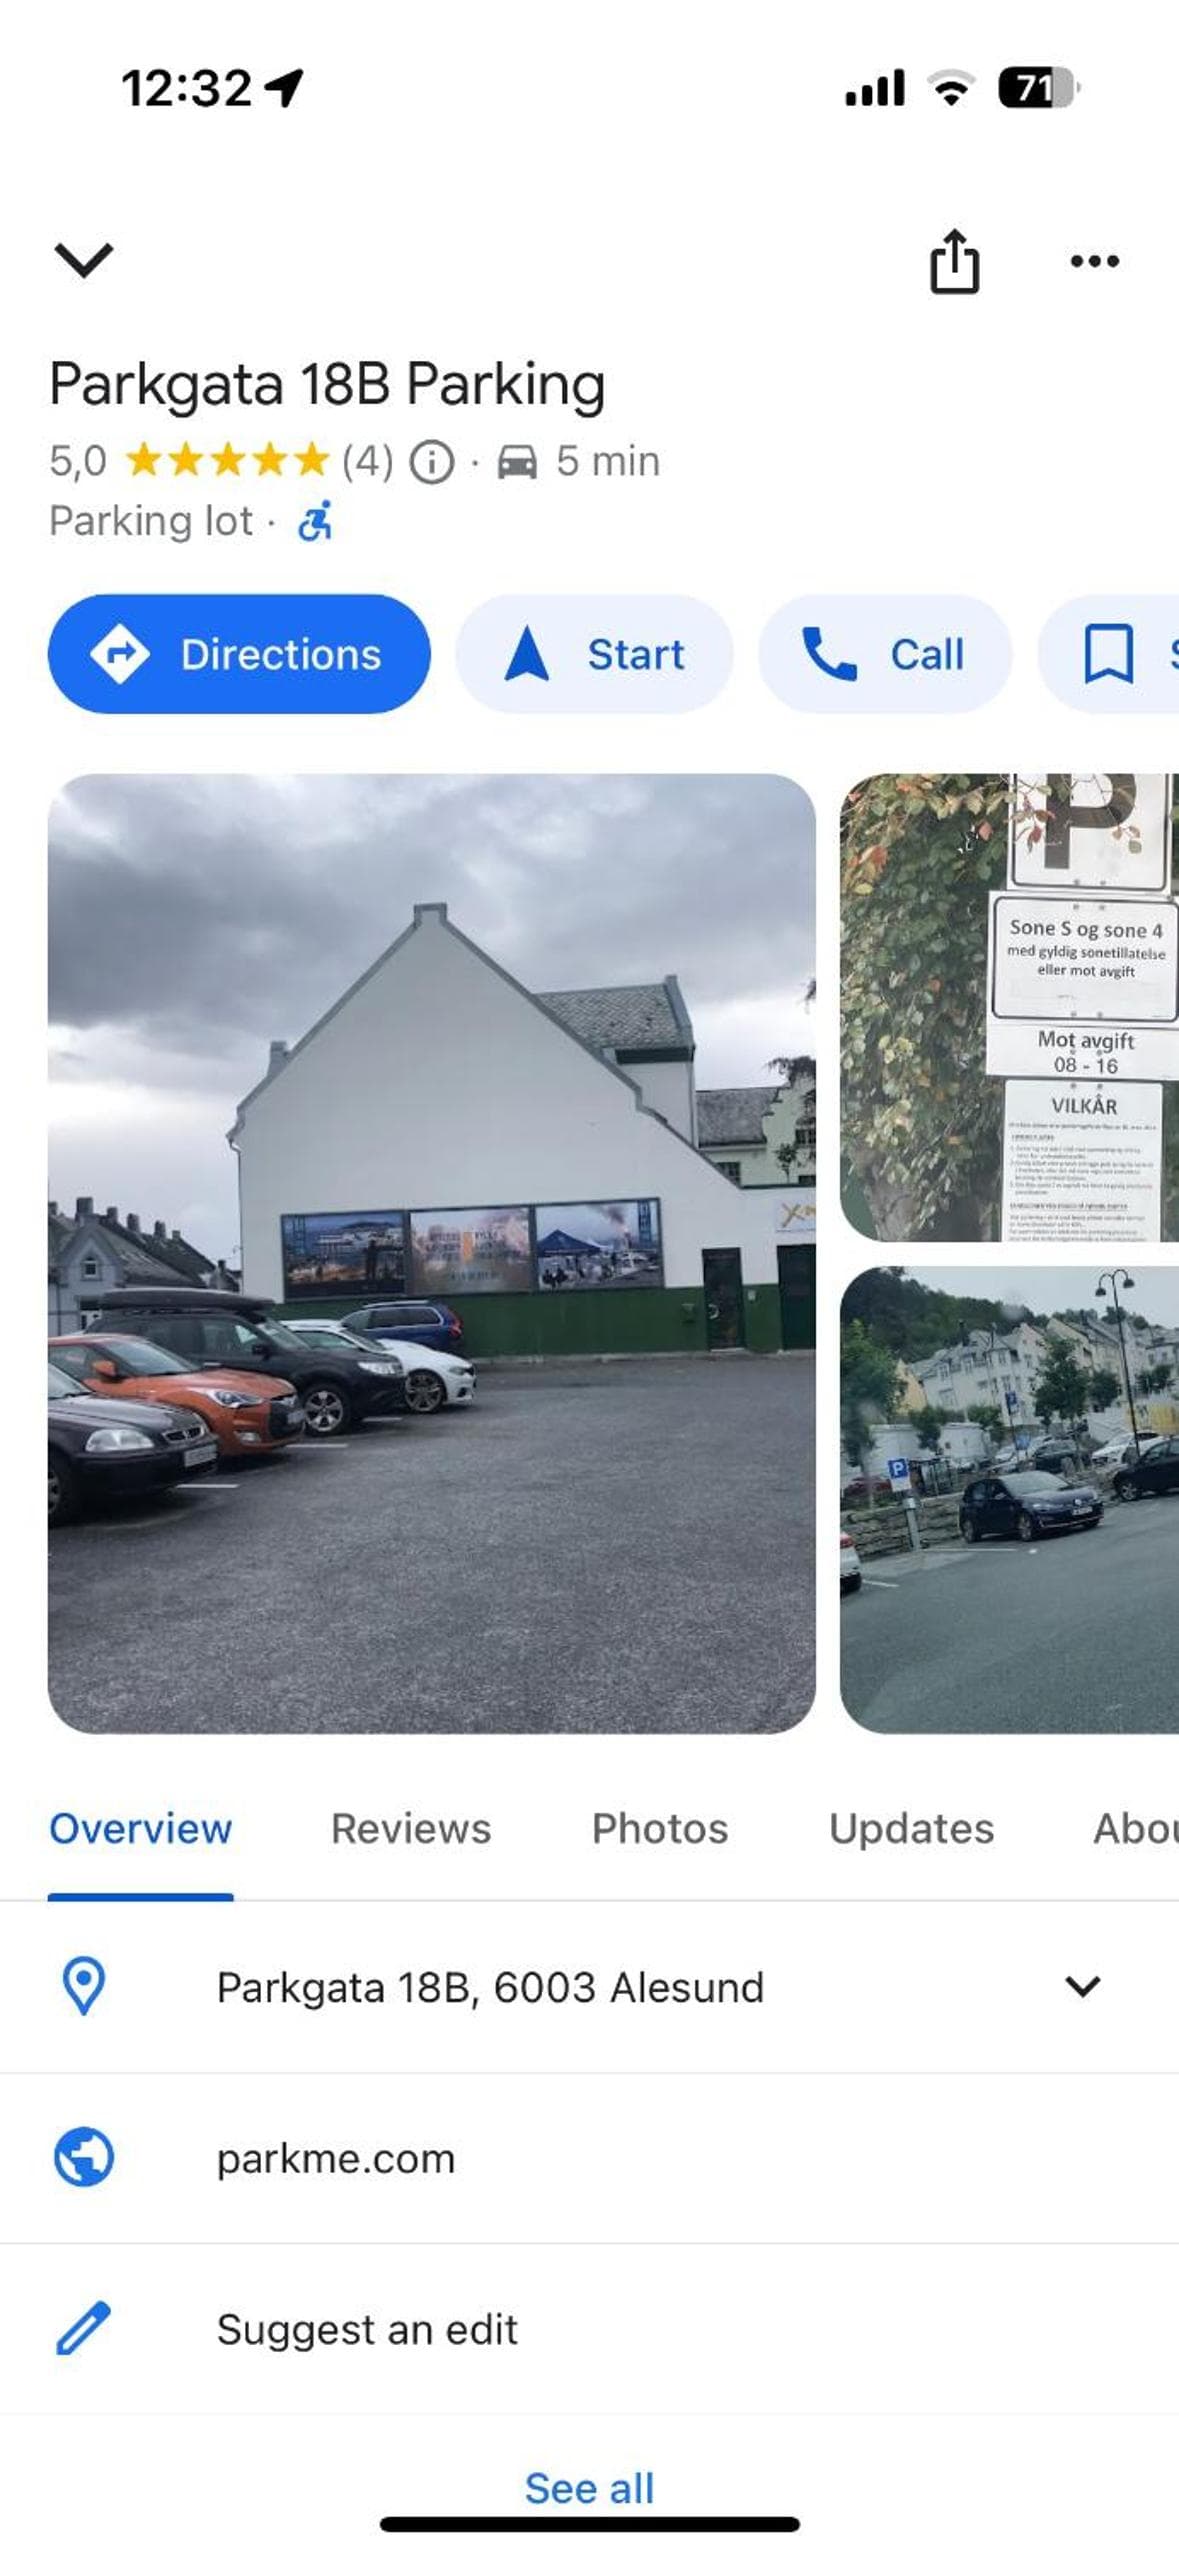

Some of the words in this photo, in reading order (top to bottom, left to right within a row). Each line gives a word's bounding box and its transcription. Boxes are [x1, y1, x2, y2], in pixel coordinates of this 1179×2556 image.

[122, 68, 251, 108] 12:32
[1017, 74, 1052, 101] 71
[52, 361, 282, 418] Parkgata
[302, 361, 390, 406] 18B
[409, 360, 604, 418] Parking
[51, 444, 106, 483] 5,0
[344, 444, 392, 483] (4)
[558, 445, 578, 476] 5
[594, 444, 659, 476] min
[51, 504, 191, 544] Parking
[207, 504, 253, 536] lot
[182, 637, 383, 672] Directions
[589, 638, 685, 670] Start
[892, 637, 963, 670] Call
[1044, 773, 1137, 869] P
[1010, 919, 1056, 936] Sone
[1061, 920, 1071, 937] S
[1077, 925, 1099, 940] og
[1103, 925, 1148, 939] sone
[1152, 923, 1163, 939] 4
[1007, 944, 1035, 957] med
[1038, 945, 1078, 960] gyldig
[1081, 946, 1166, 961] sonetillatelse
[1037, 963, 1067, 976] eller
[1070, 965, 1097, 977] mot
[1100, 965, 1136, 980] avgift
[1038, 1030, 1076, 1048] Mot
[1081, 1032, 1135, 1054] avgift
[1054, 1056, 1077, 1073] 08
[1097, 1058, 1118, 1074] 16
[1052, 1093, 1118, 1115] VILKÅR
[49, 1811, 232, 1845] Overview
[333, 1811, 491, 1844] Reviews
[594, 1811, 728, 1844] Photos
[831, 1811, 994, 1851] Updates
[1093, 1811, 1179, 1844] Abo
[219, 1971, 384, 2011] Parkgata
[399, 1971, 480, 2010] 18B,
[495, 1971, 595, 2003] 6003
[610, 1971, 764, 2003] Alesund
[218, 2141, 455, 2181] parkme.com
[218, 2313, 376, 2352] Suggest
[388, 2321, 432, 2345] an
[446, 2312, 518, 2345] edit
[526, 2472, 597, 2505] See
[610, 2471, 654, 2504] all
